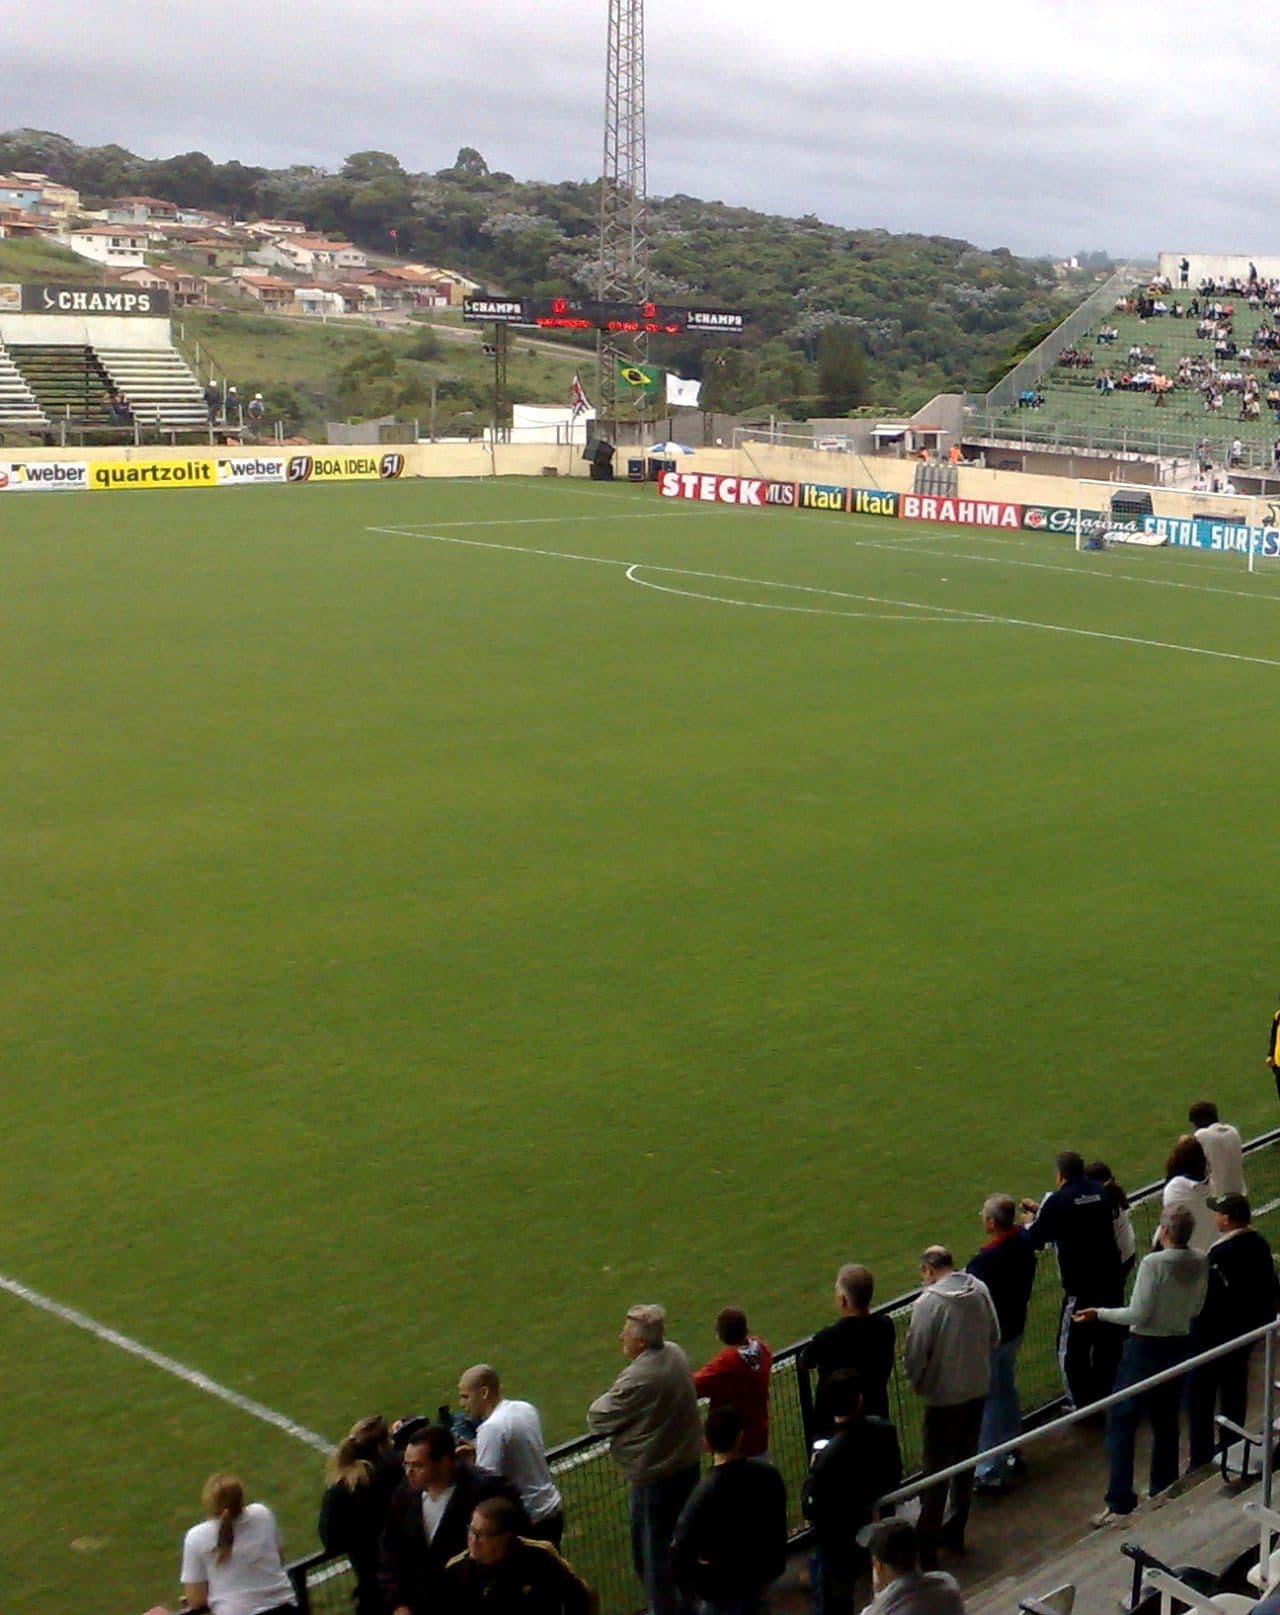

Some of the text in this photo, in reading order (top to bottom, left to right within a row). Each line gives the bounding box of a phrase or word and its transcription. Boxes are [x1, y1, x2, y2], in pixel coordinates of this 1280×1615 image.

[58, 291, 150, 312] CHAMPS
[472, 301, 521, 313] CHAMPS
[695, 312, 742, 326] CHAMPS
[26, 464, 85, 481] weber
[96, 462, 210, 487] quartzolit
[230, 459, 282, 476] weber
[289, 456, 398, 480] 51 BOA IDEIA 51
[662, 472, 762, 506] STECK
[803, 485, 842, 511] Itaú
[856, 491, 895, 515] Itaú
[904, 497, 1018, 527] BRAHMA
